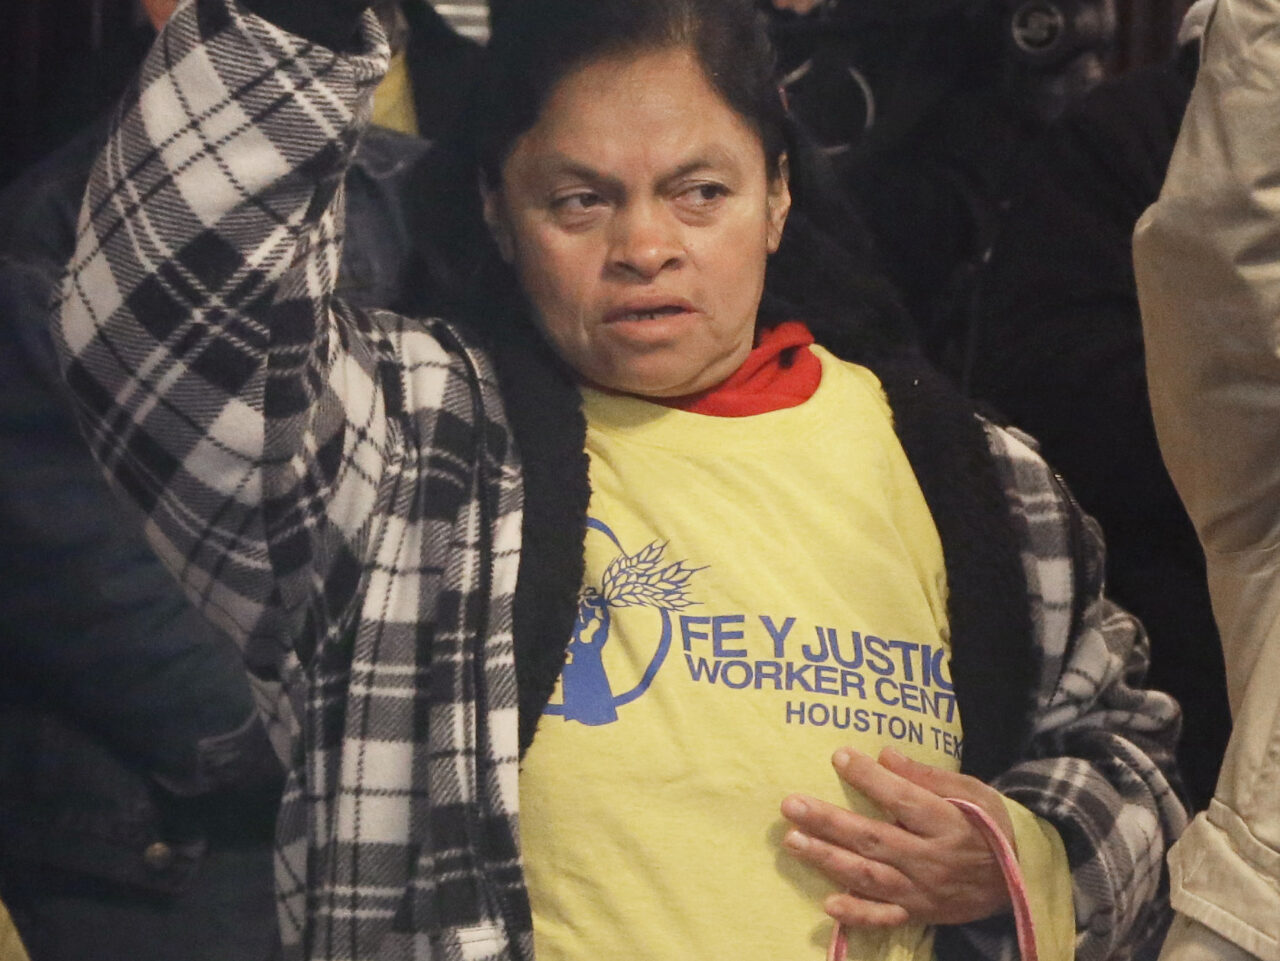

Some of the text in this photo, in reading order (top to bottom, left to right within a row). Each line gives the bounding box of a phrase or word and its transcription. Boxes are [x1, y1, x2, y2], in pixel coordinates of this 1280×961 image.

[678, 614, 748, 659] FE
[759, 615, 797, 660] Y
[683, 652, 867, 700] WORKER
[786, 701, 924, 746] HOUSTON
